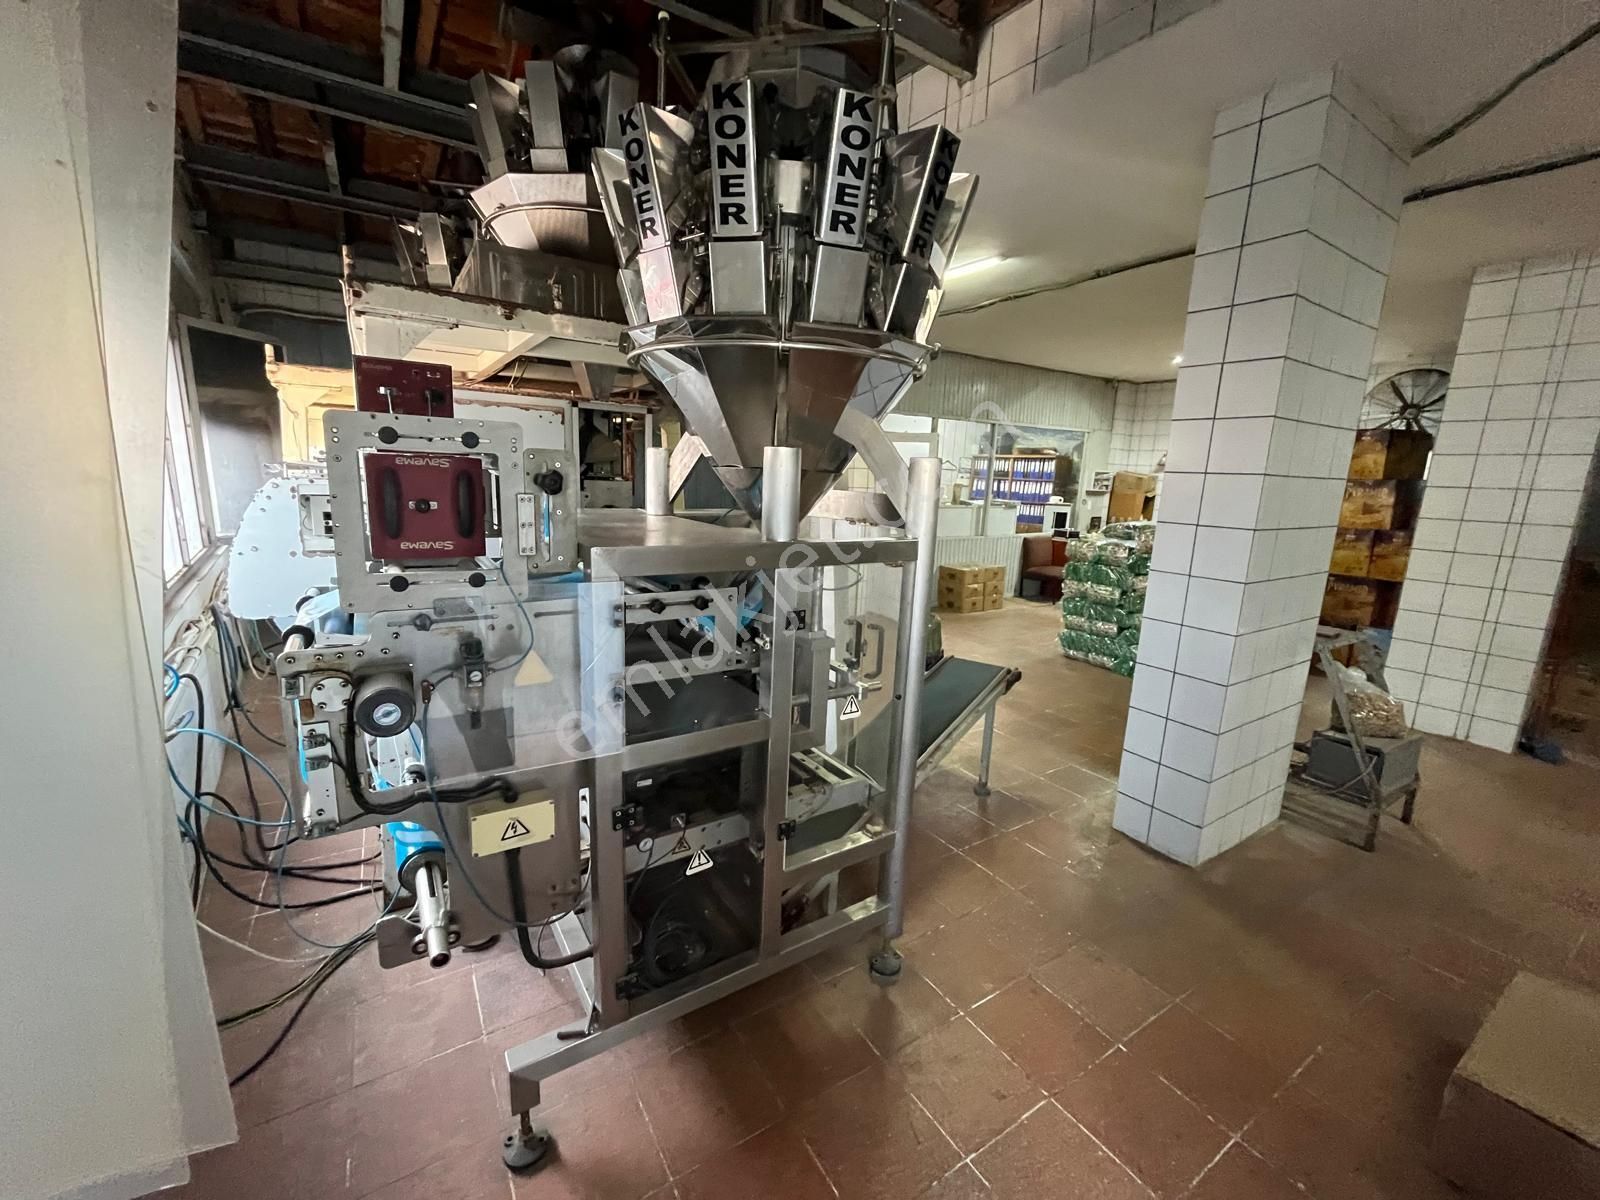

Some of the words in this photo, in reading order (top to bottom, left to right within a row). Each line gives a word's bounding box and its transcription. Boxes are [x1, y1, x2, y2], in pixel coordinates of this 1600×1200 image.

[618, 107, 659, 240] KONER
[712, 82, 749, 226] KONER
[829, 92, 875, 235] KONER
[911, 136, 961, 260] KONER
